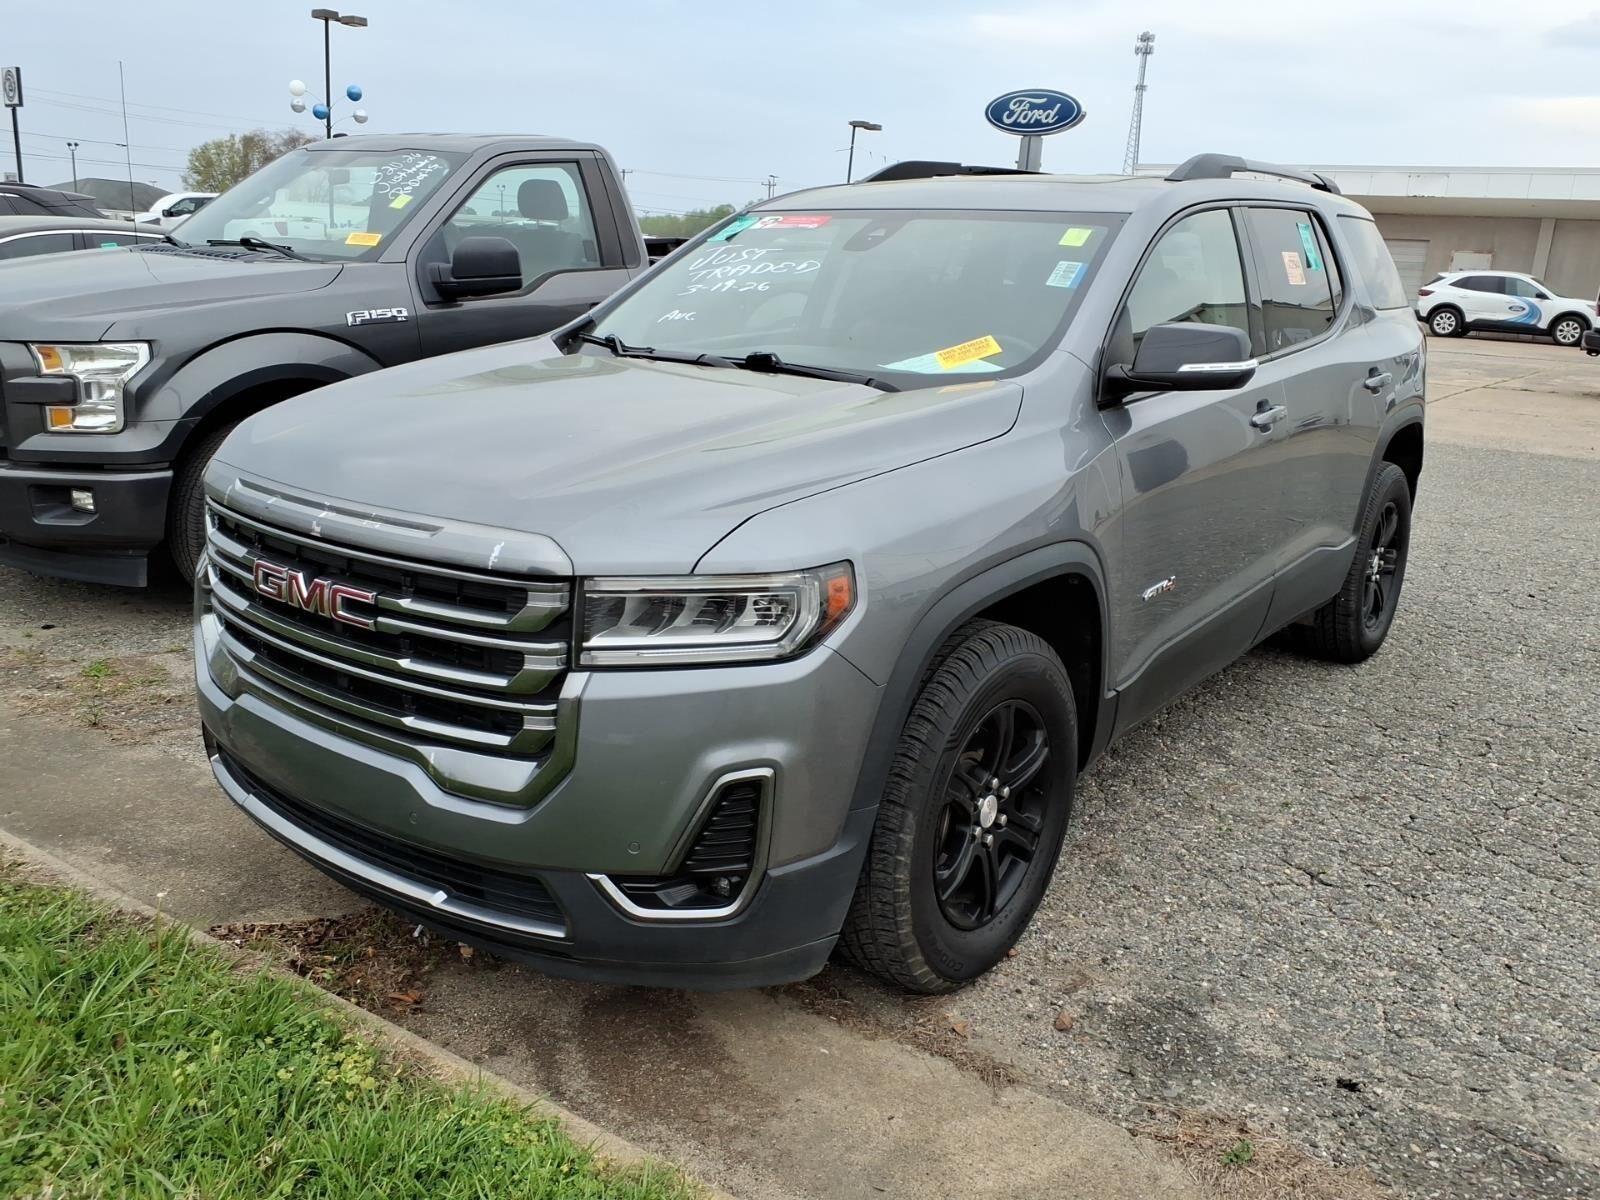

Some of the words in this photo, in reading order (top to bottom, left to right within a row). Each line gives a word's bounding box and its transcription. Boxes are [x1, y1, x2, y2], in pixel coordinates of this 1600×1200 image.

[1002, 97, 1062, 124] Ford
[688, 245, 784, 271] JUST
[689, 260, 821, 282] TRADED
[678, 279, 771, 296] 3-19-26
[253, 560, 377, 632] GMC
